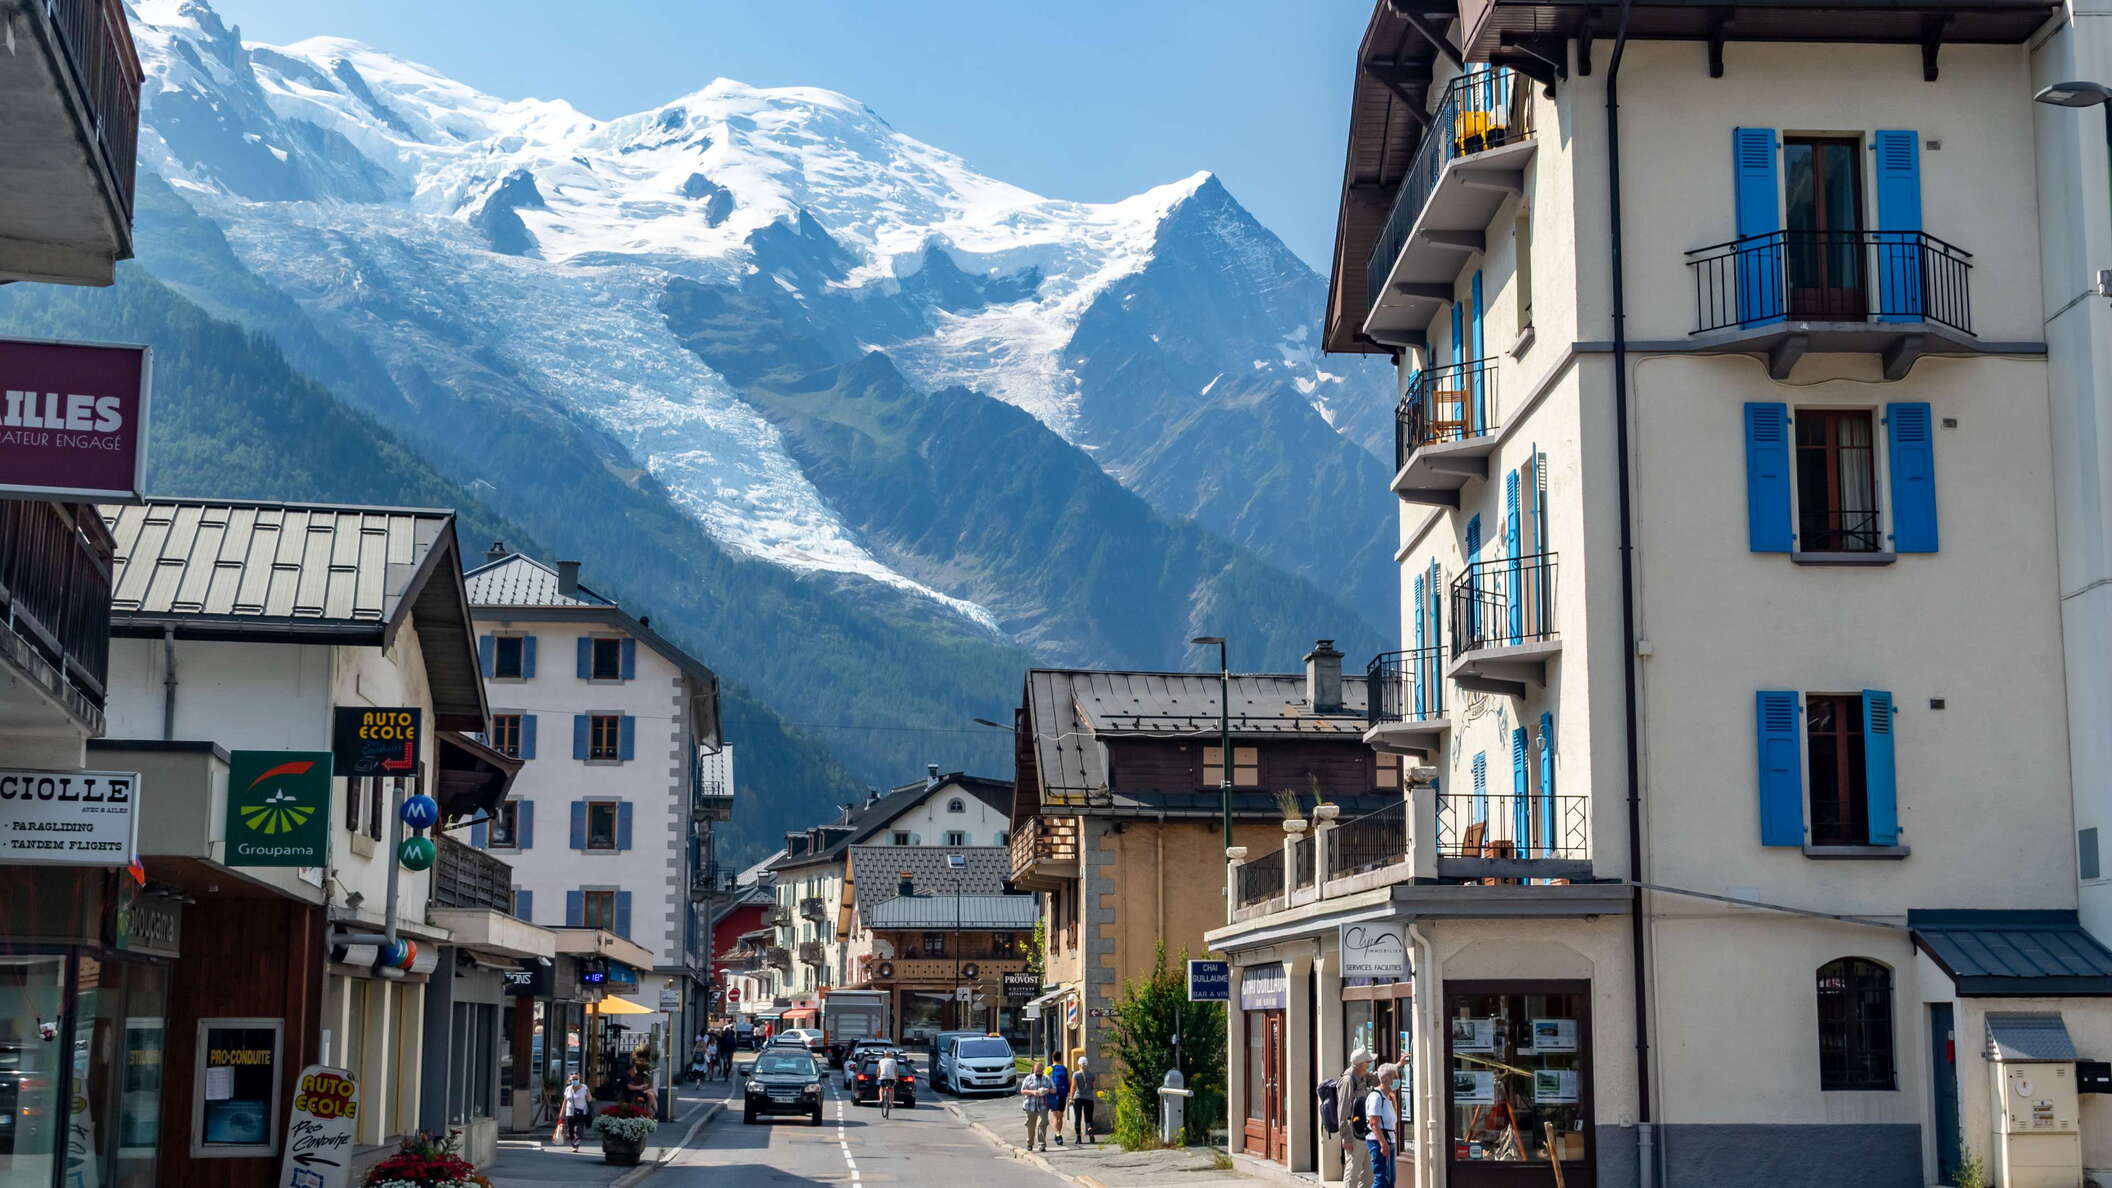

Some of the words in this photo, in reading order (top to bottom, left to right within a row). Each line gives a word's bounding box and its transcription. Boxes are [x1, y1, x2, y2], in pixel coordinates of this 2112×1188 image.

[0, 390, 122, 432] ILLES
[0, 431, 48, 446] ATEUR
[56, 434, 120, 451] ENGAGÉ
[363, 712, 412, 726] AUTO
[359, 726, 415, 739] ECOLE
[0, 776, 129, 802] CIOLLE
[407, 803, 426, 818] M
[12, 821, 94, 832] PARAGLIDING
[11, 840, 64, 849] TANDEM
[69, 841, 122, 851] FLIGHTS
[238, 843, 314, 858] Groupama
[404, 846, 423, 860] M
[1202, 964, 1218, 972] CHAI
[1005, 976, 1039, 984] PROVOST
[1192, 974, 1228, 983] GUILLAUME
[210, 1049, 272, 1065] PRO-CONDUITE
[303, 1075, 354, 1097] AUTO
[295, 1095, 357, 1118] ECOLE
